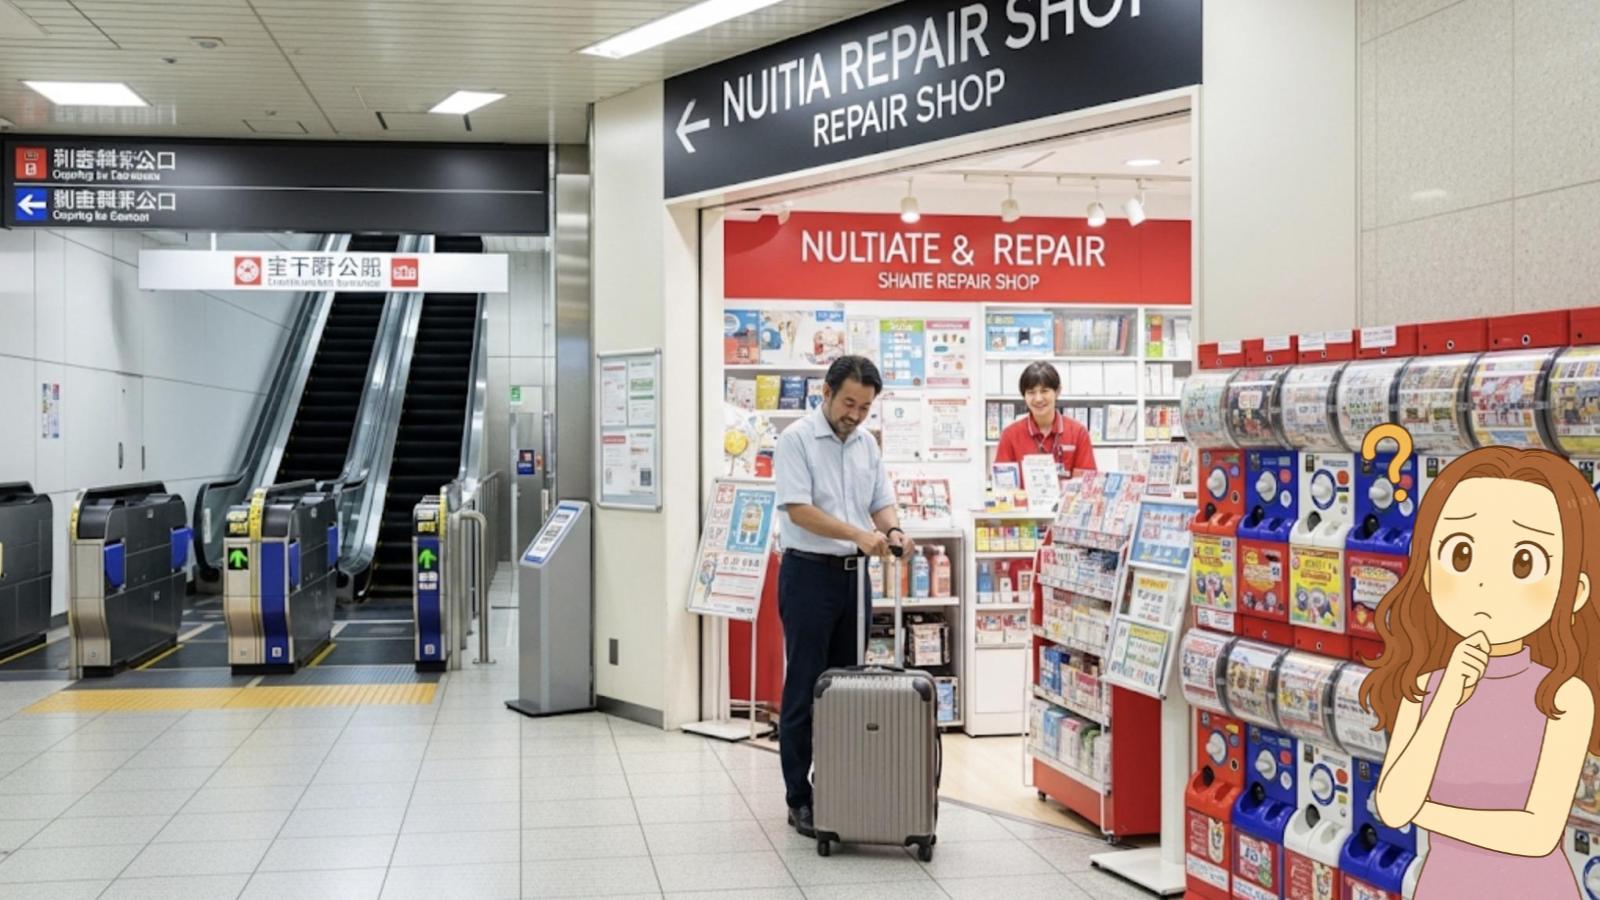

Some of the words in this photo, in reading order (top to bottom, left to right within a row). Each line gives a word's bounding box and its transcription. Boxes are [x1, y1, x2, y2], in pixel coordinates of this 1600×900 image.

[723, 52, 831, 127] NUITIA
[840, 3, 990, 94] REPAIR
[813, 91, 908, 148] REPAIR
[916, 68, 1006, 124] SHOP
[802, 230, 941, 264] NULTIATE
[951, 234, 975, 266] &
[994, 233, 1106, 267] REPAIR
[937, 273, 991, 290] REPAIR
[995, 274, 1041, 291] SHOP
